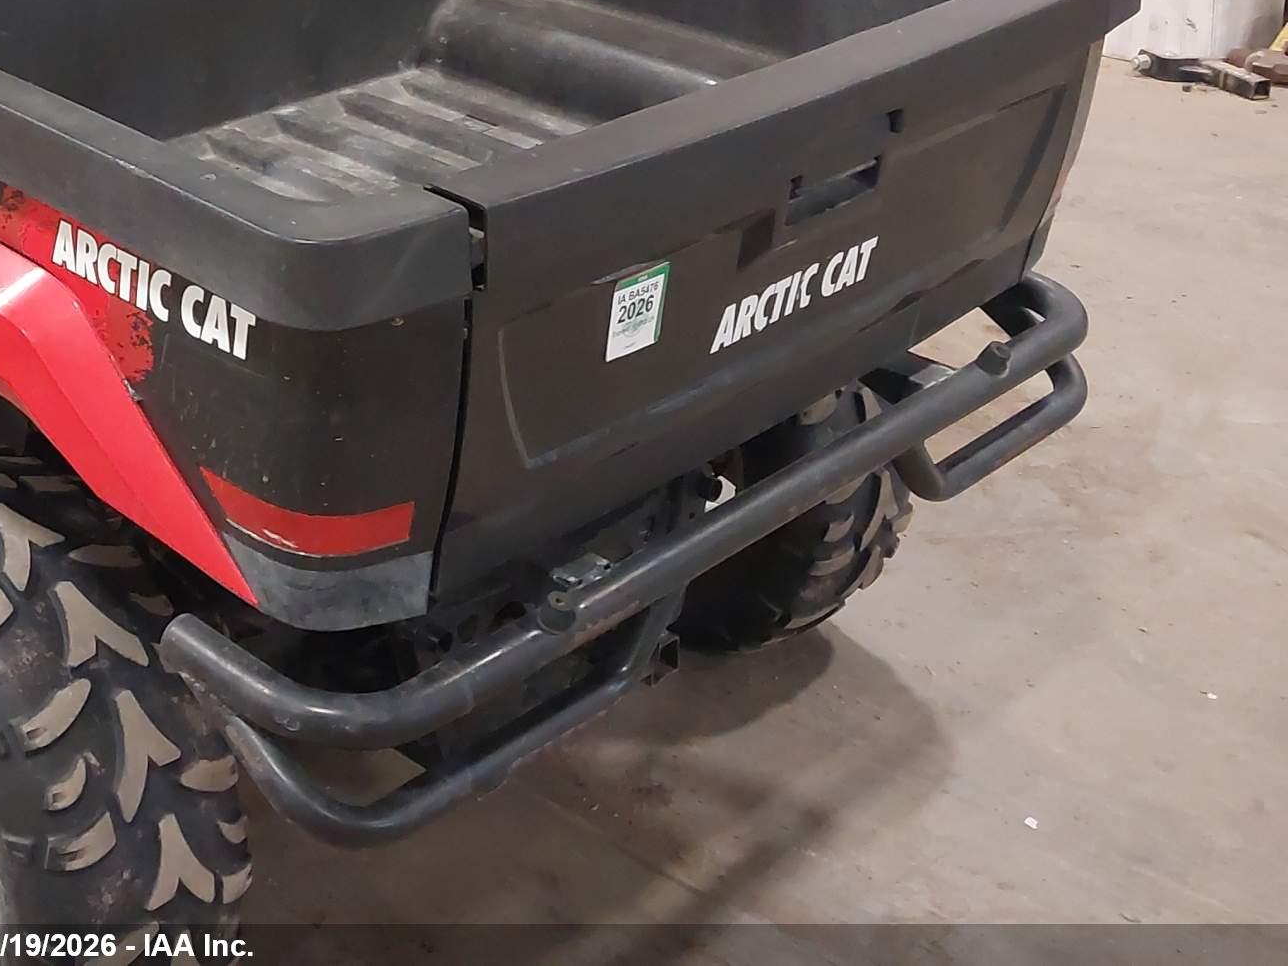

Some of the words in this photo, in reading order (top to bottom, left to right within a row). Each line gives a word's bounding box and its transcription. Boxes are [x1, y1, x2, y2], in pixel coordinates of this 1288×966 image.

[51, 219, 172, 323] ARCTIC
[180, 284, 257, 361] CAT
[617, 294, 655, 324] 2026
[709, 262, 820, 355] ARCTIC
[821, 235, 879, 298] CAT
